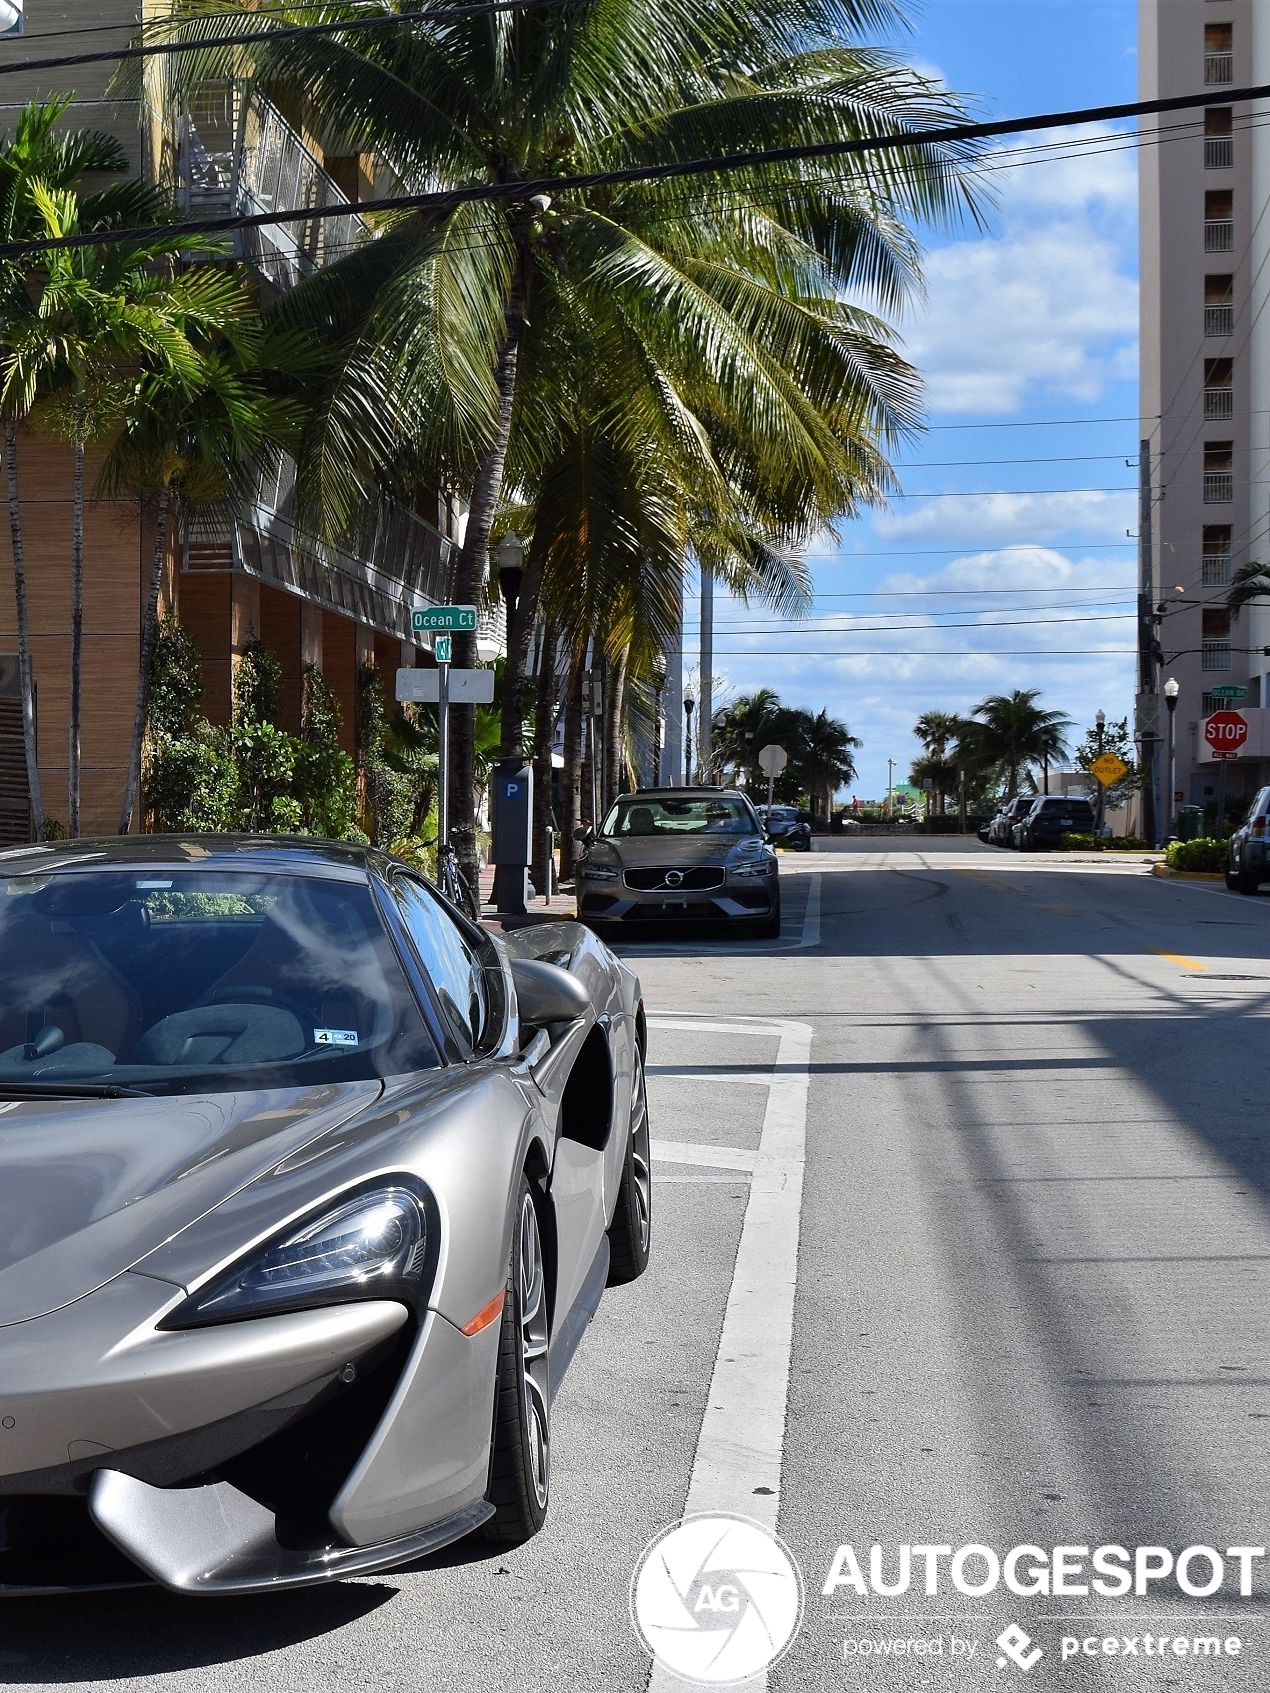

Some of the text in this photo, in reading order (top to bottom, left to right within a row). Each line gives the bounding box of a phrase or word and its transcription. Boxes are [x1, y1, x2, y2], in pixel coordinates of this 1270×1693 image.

[414, 612, 474, 627] Ocean Ct
[1213, 688, 1247, 697] OCEAN DR
[1206, 723, 1246, 740] STOP
[1103, 757, 1115, 765] NO
[1094, 766, 1123, 775] OUTLET
[507, 783, 518, 797] P
[318, 1032, 356, 1042] 4 20
